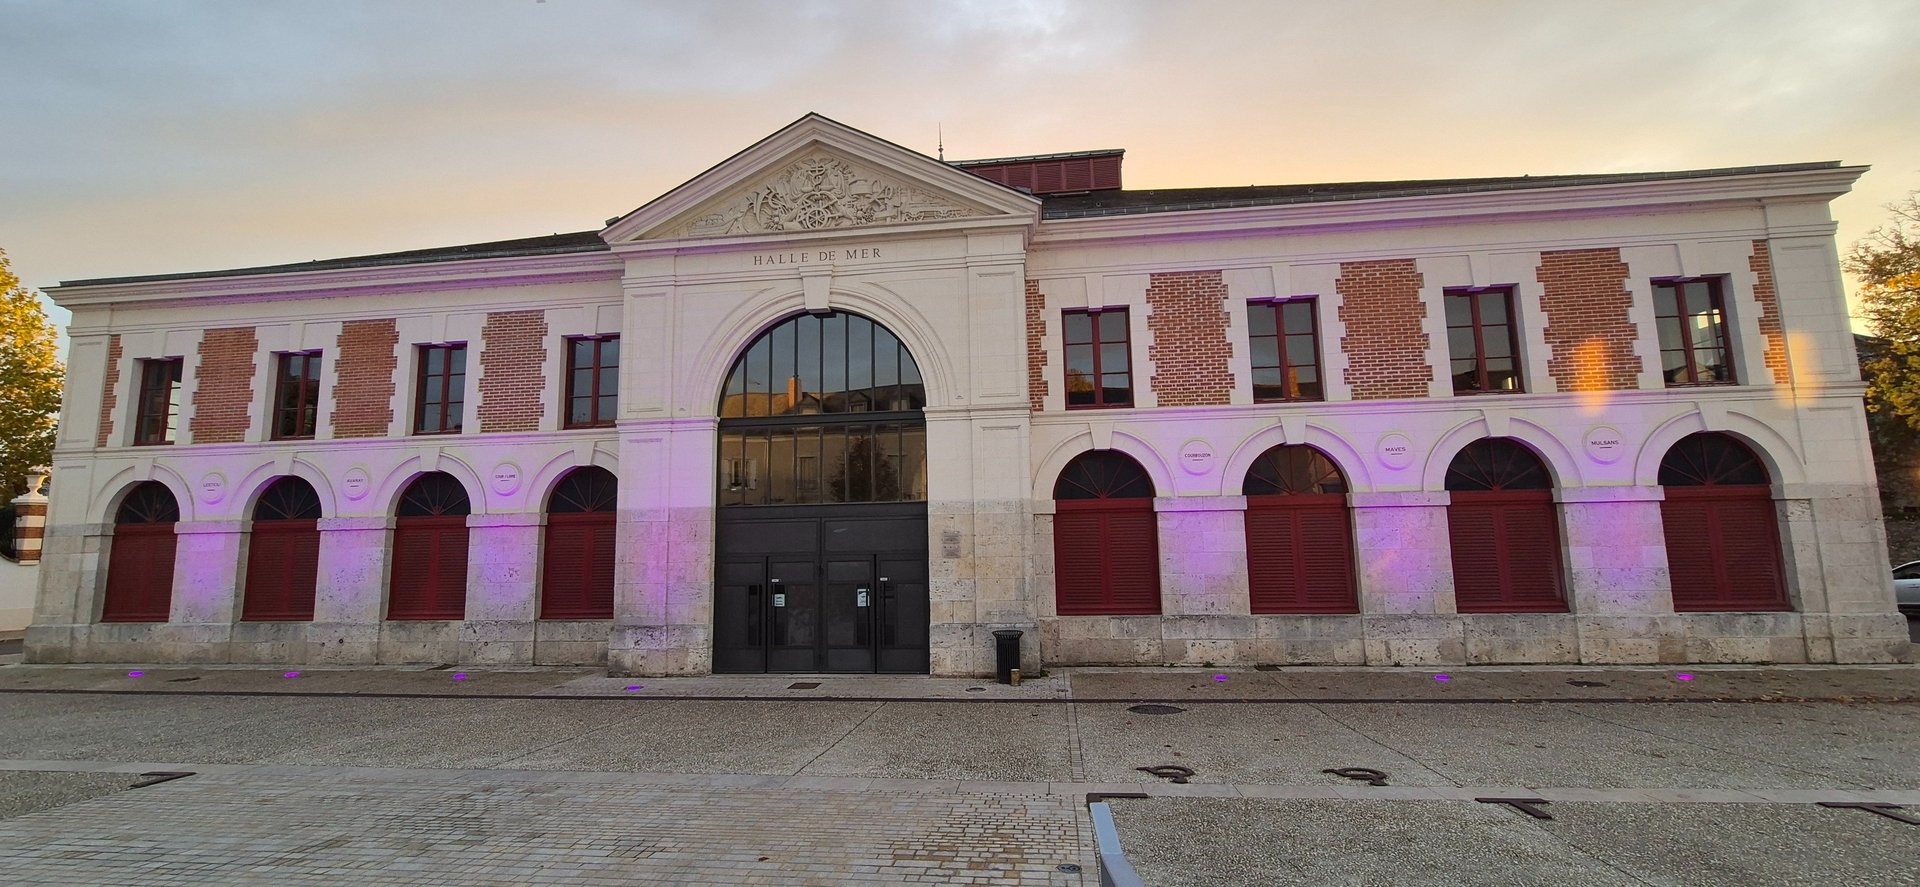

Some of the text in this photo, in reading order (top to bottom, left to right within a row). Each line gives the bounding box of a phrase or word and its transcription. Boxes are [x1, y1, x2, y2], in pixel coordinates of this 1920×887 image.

[754, 247, 881, 266] HALLE DE MER
